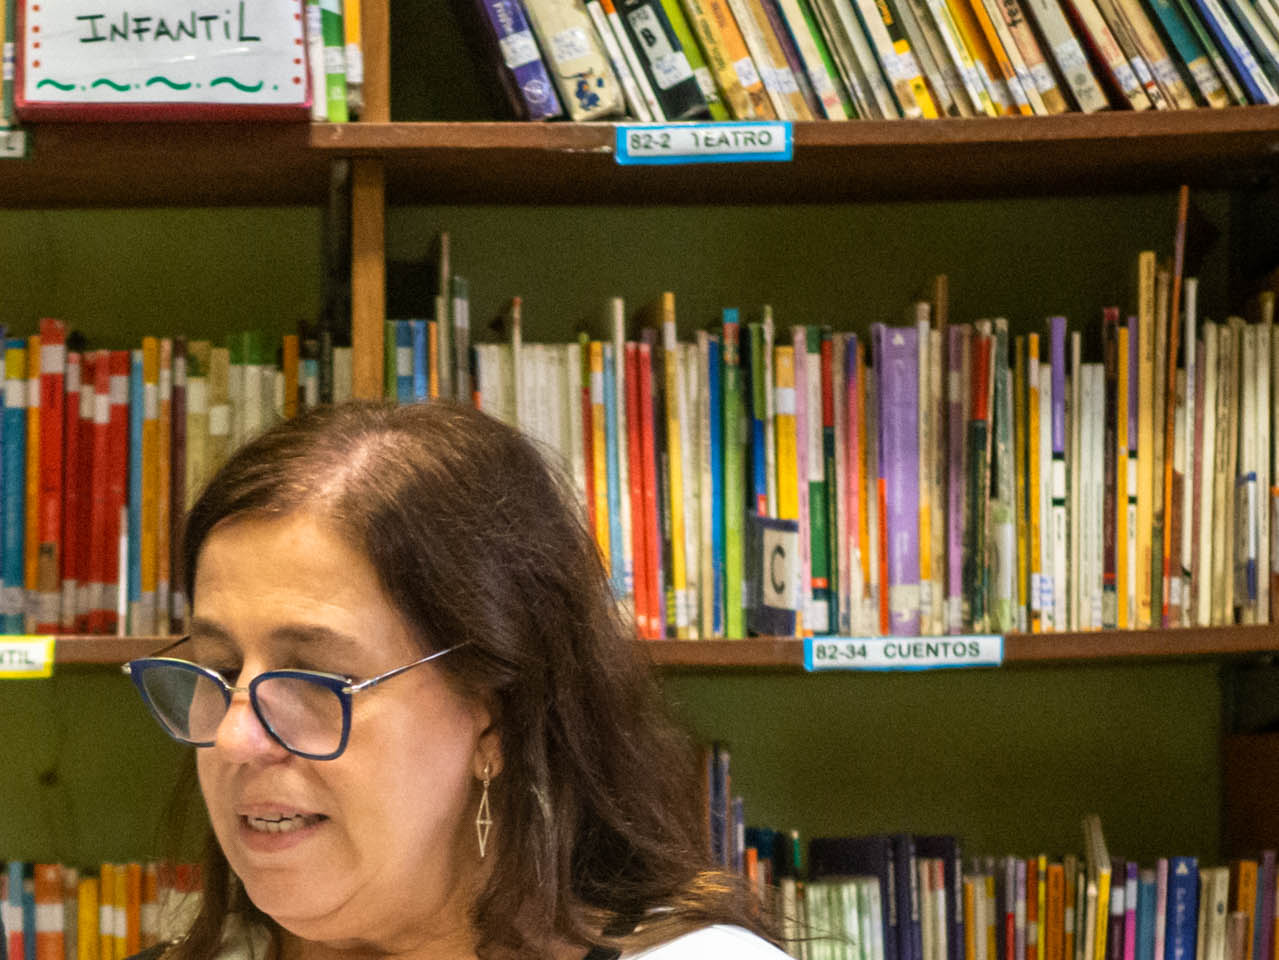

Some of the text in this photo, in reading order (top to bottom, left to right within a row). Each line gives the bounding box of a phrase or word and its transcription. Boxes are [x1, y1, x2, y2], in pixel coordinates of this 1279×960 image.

[630, 130, 773, 150] 82-2 TEATRO
[815, 641, 981, 660] 82-34 CUENTOS
